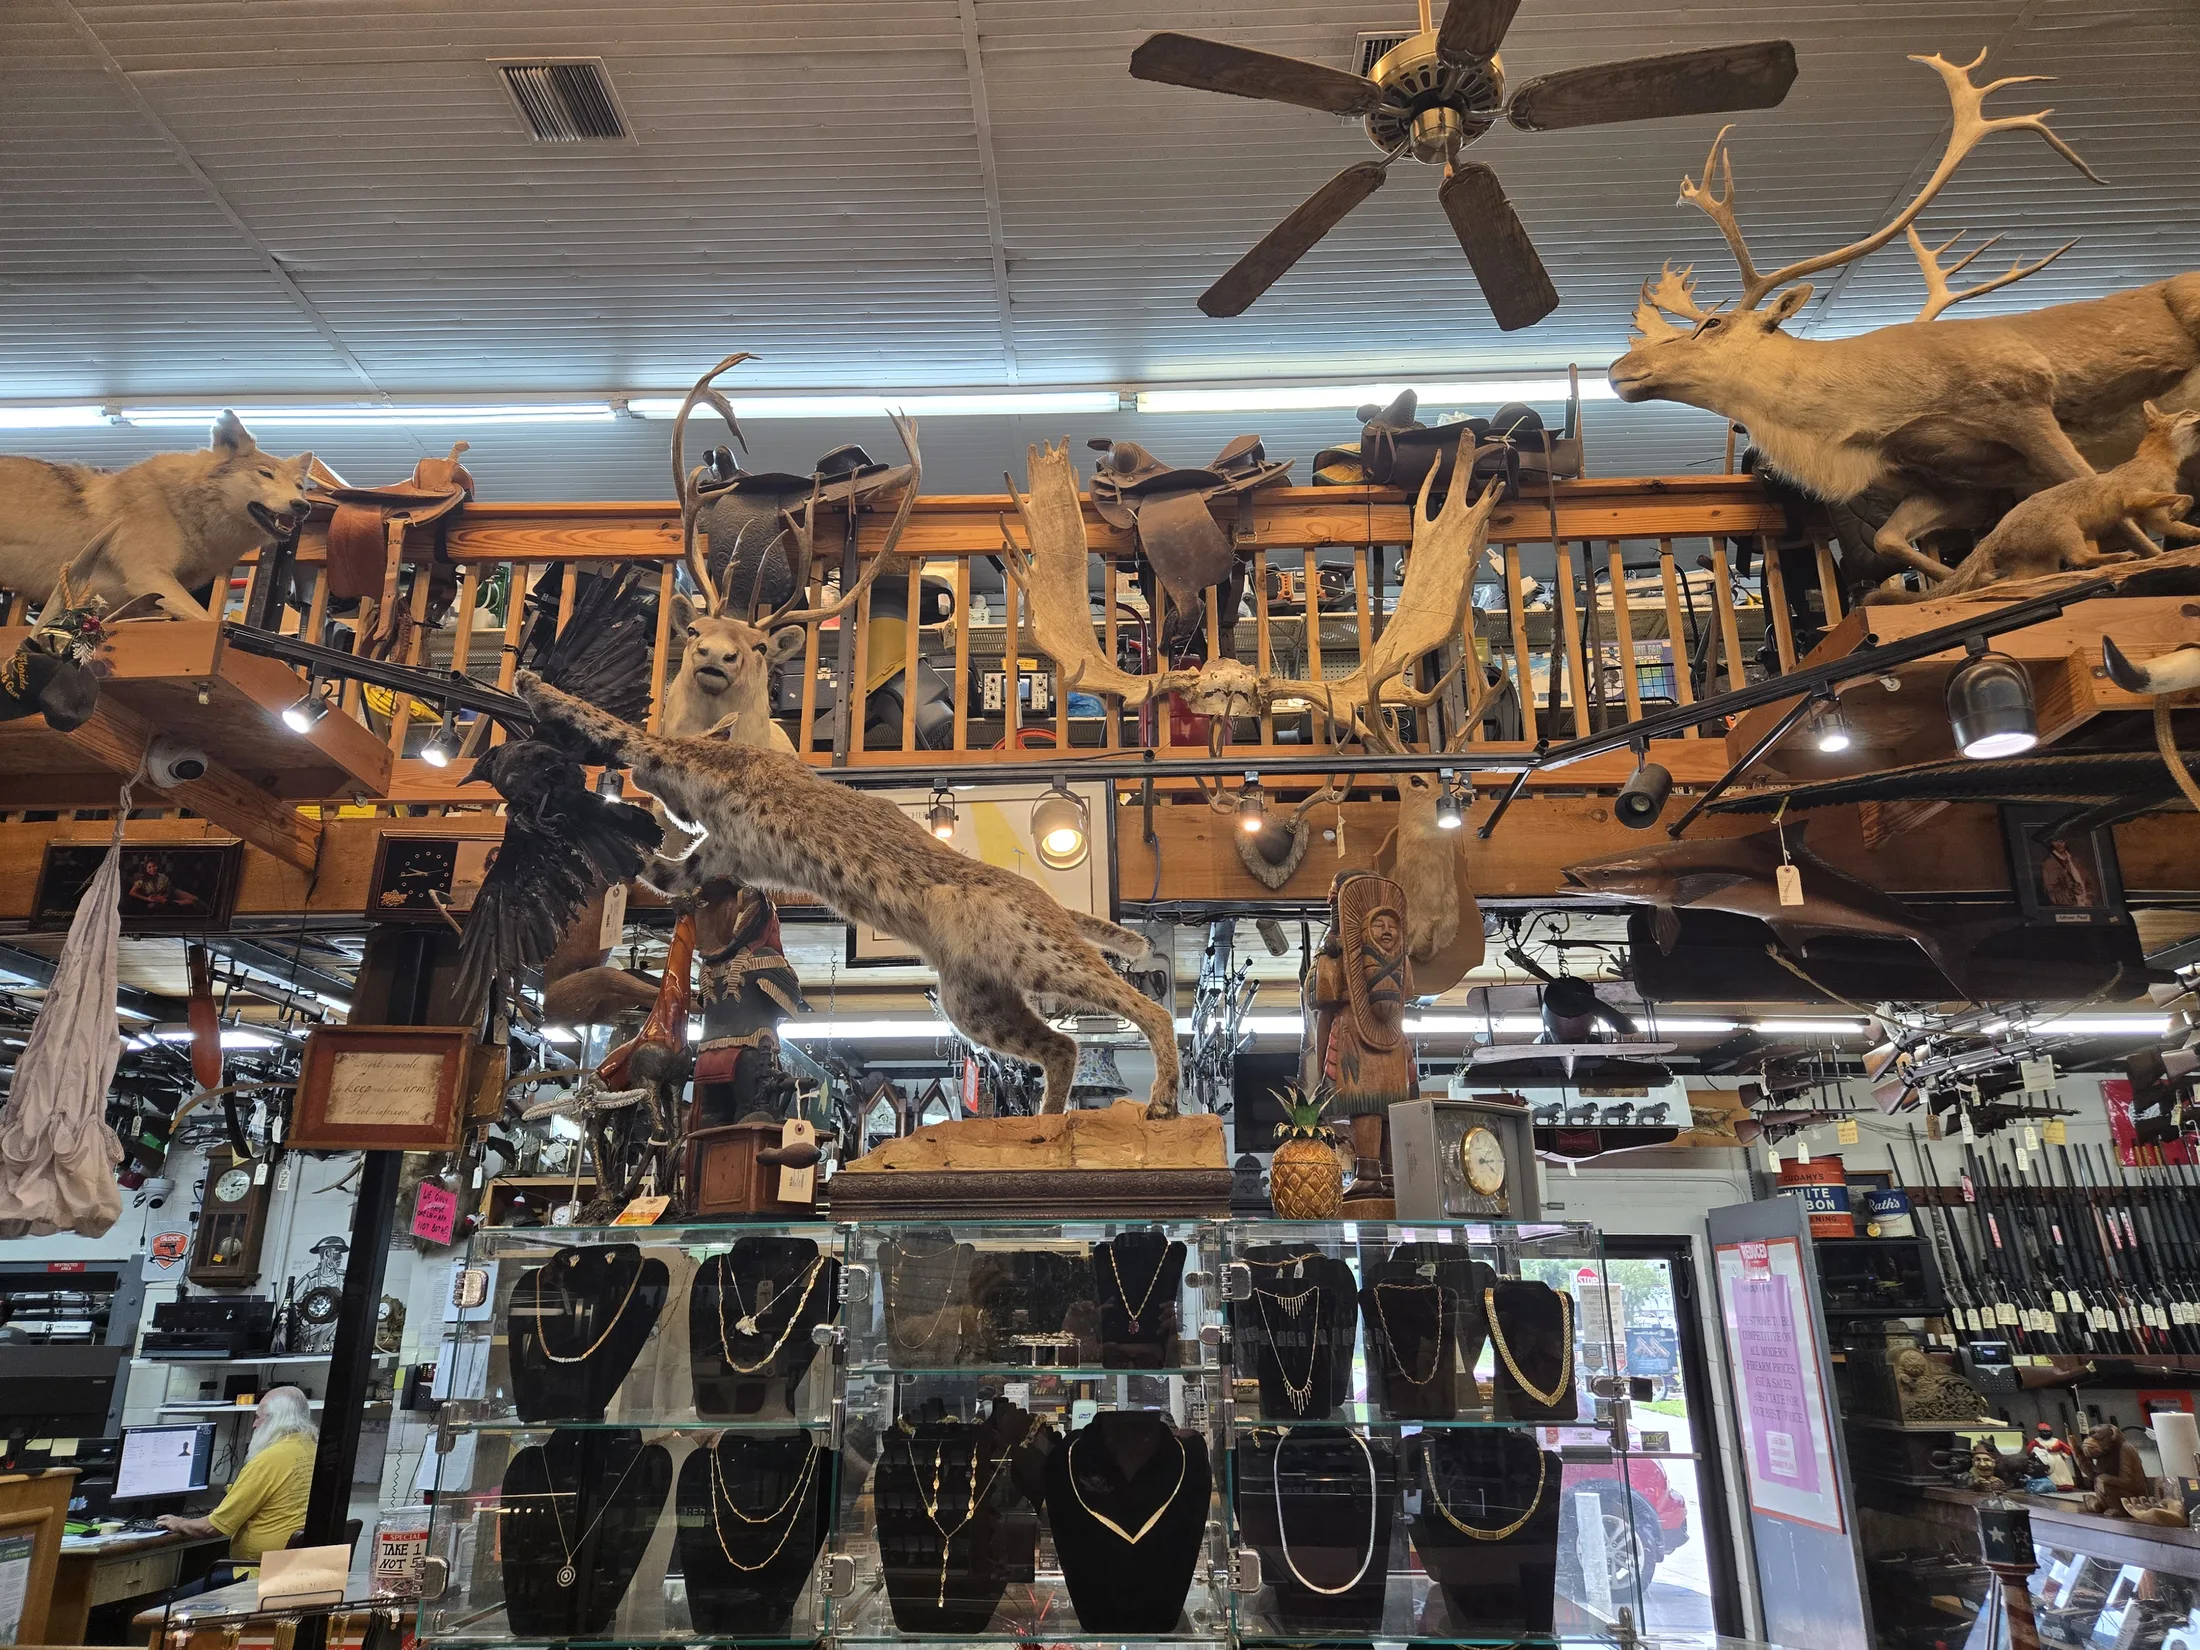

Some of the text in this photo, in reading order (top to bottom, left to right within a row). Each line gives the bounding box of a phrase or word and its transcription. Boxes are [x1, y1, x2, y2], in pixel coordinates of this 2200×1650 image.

[403, 1085, 433, 1094] arms
[1784, 1173, 1824, 1182] CUDAHY'S
[1784, 1187, 1831, 1199] WHITE
[1868, 1197, 1901, 1213] Rath's
[1577, 1275, 1599, 1284] STOP
[1742, 1330, 1781, 1342] COMPETITIVE
[1760, 1346, 1789, 1358] MODERN
[1746, 1359, 1772, 1373] FIREARM
[390, 1533, 421, 1541] SPECIAL
[382, 1542, 421, 1556] TAKE 1
[378, 1558, 407, 1569] NOT
